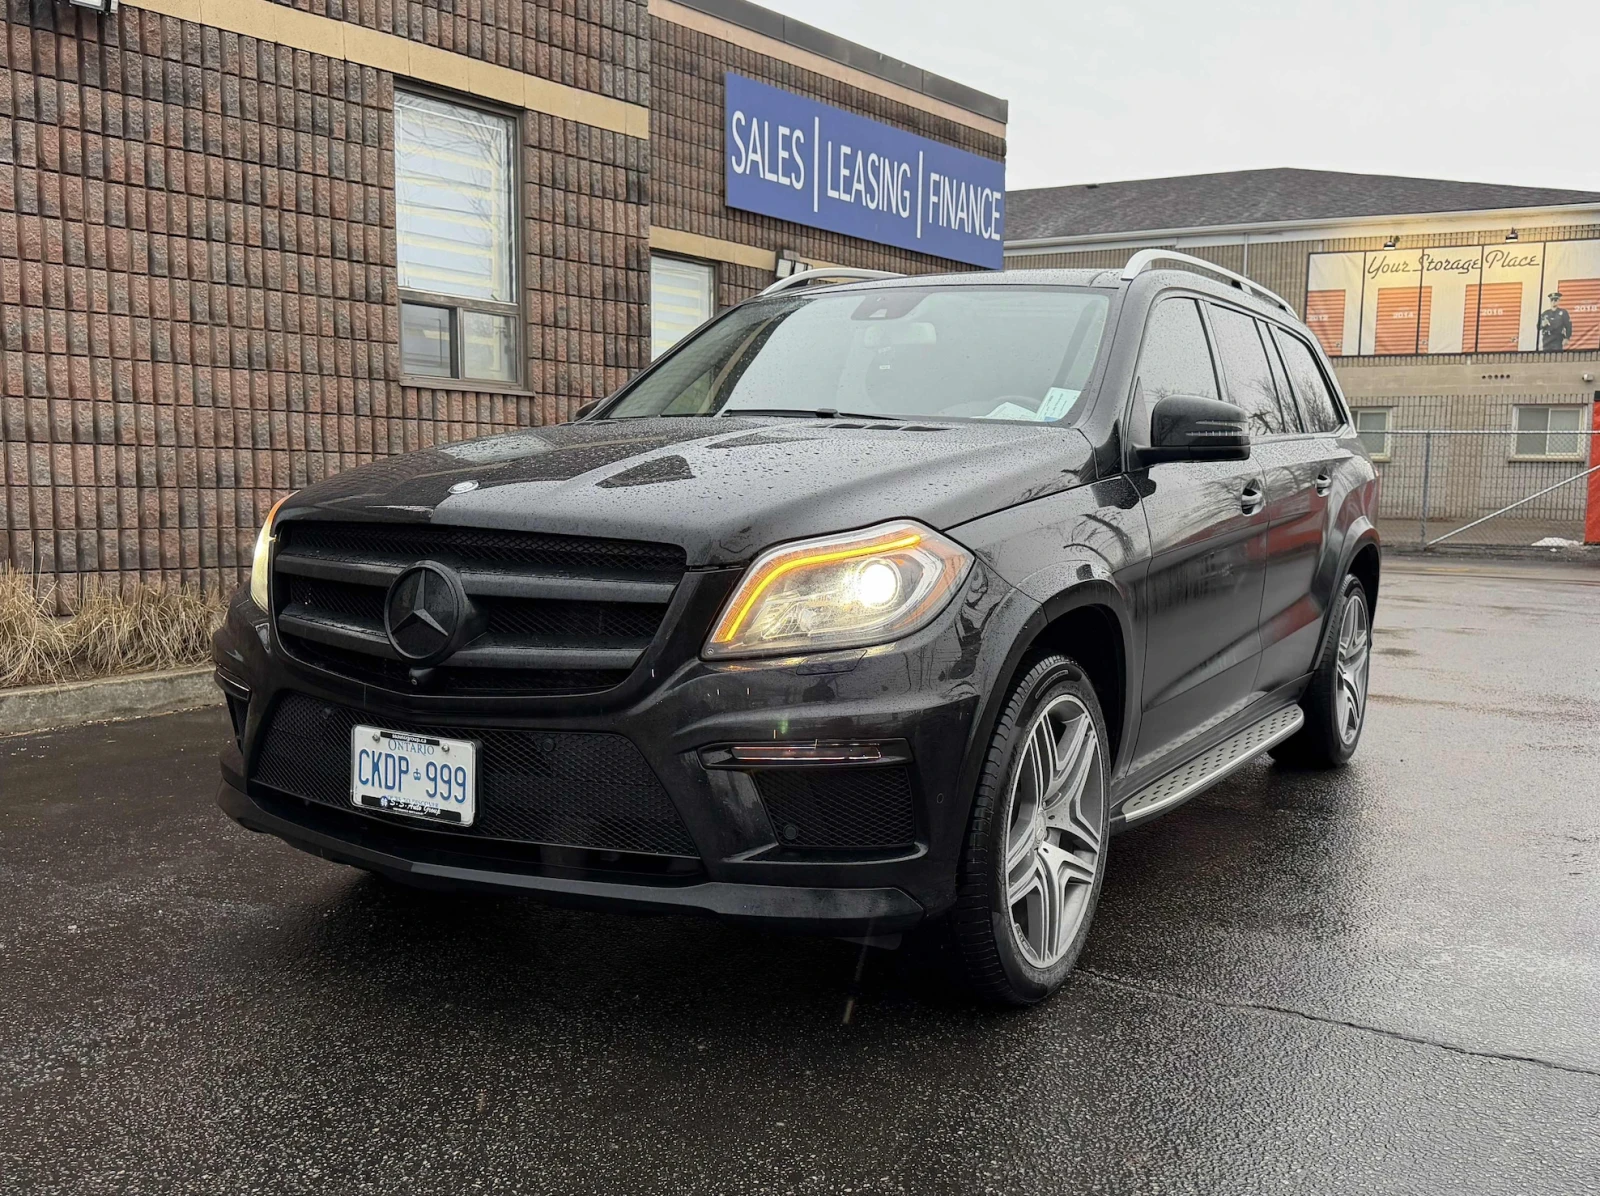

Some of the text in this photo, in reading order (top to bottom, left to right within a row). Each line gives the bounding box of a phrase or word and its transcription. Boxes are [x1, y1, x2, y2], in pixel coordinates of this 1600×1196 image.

[731, 110, 1002, 241] SALES LEASING FINANCE
[1367, 249, 1540, 280] Your Storage Place
[388, 738, 435, 756] ONTARIO
[358, 748, 467, 804] CKDP 999
